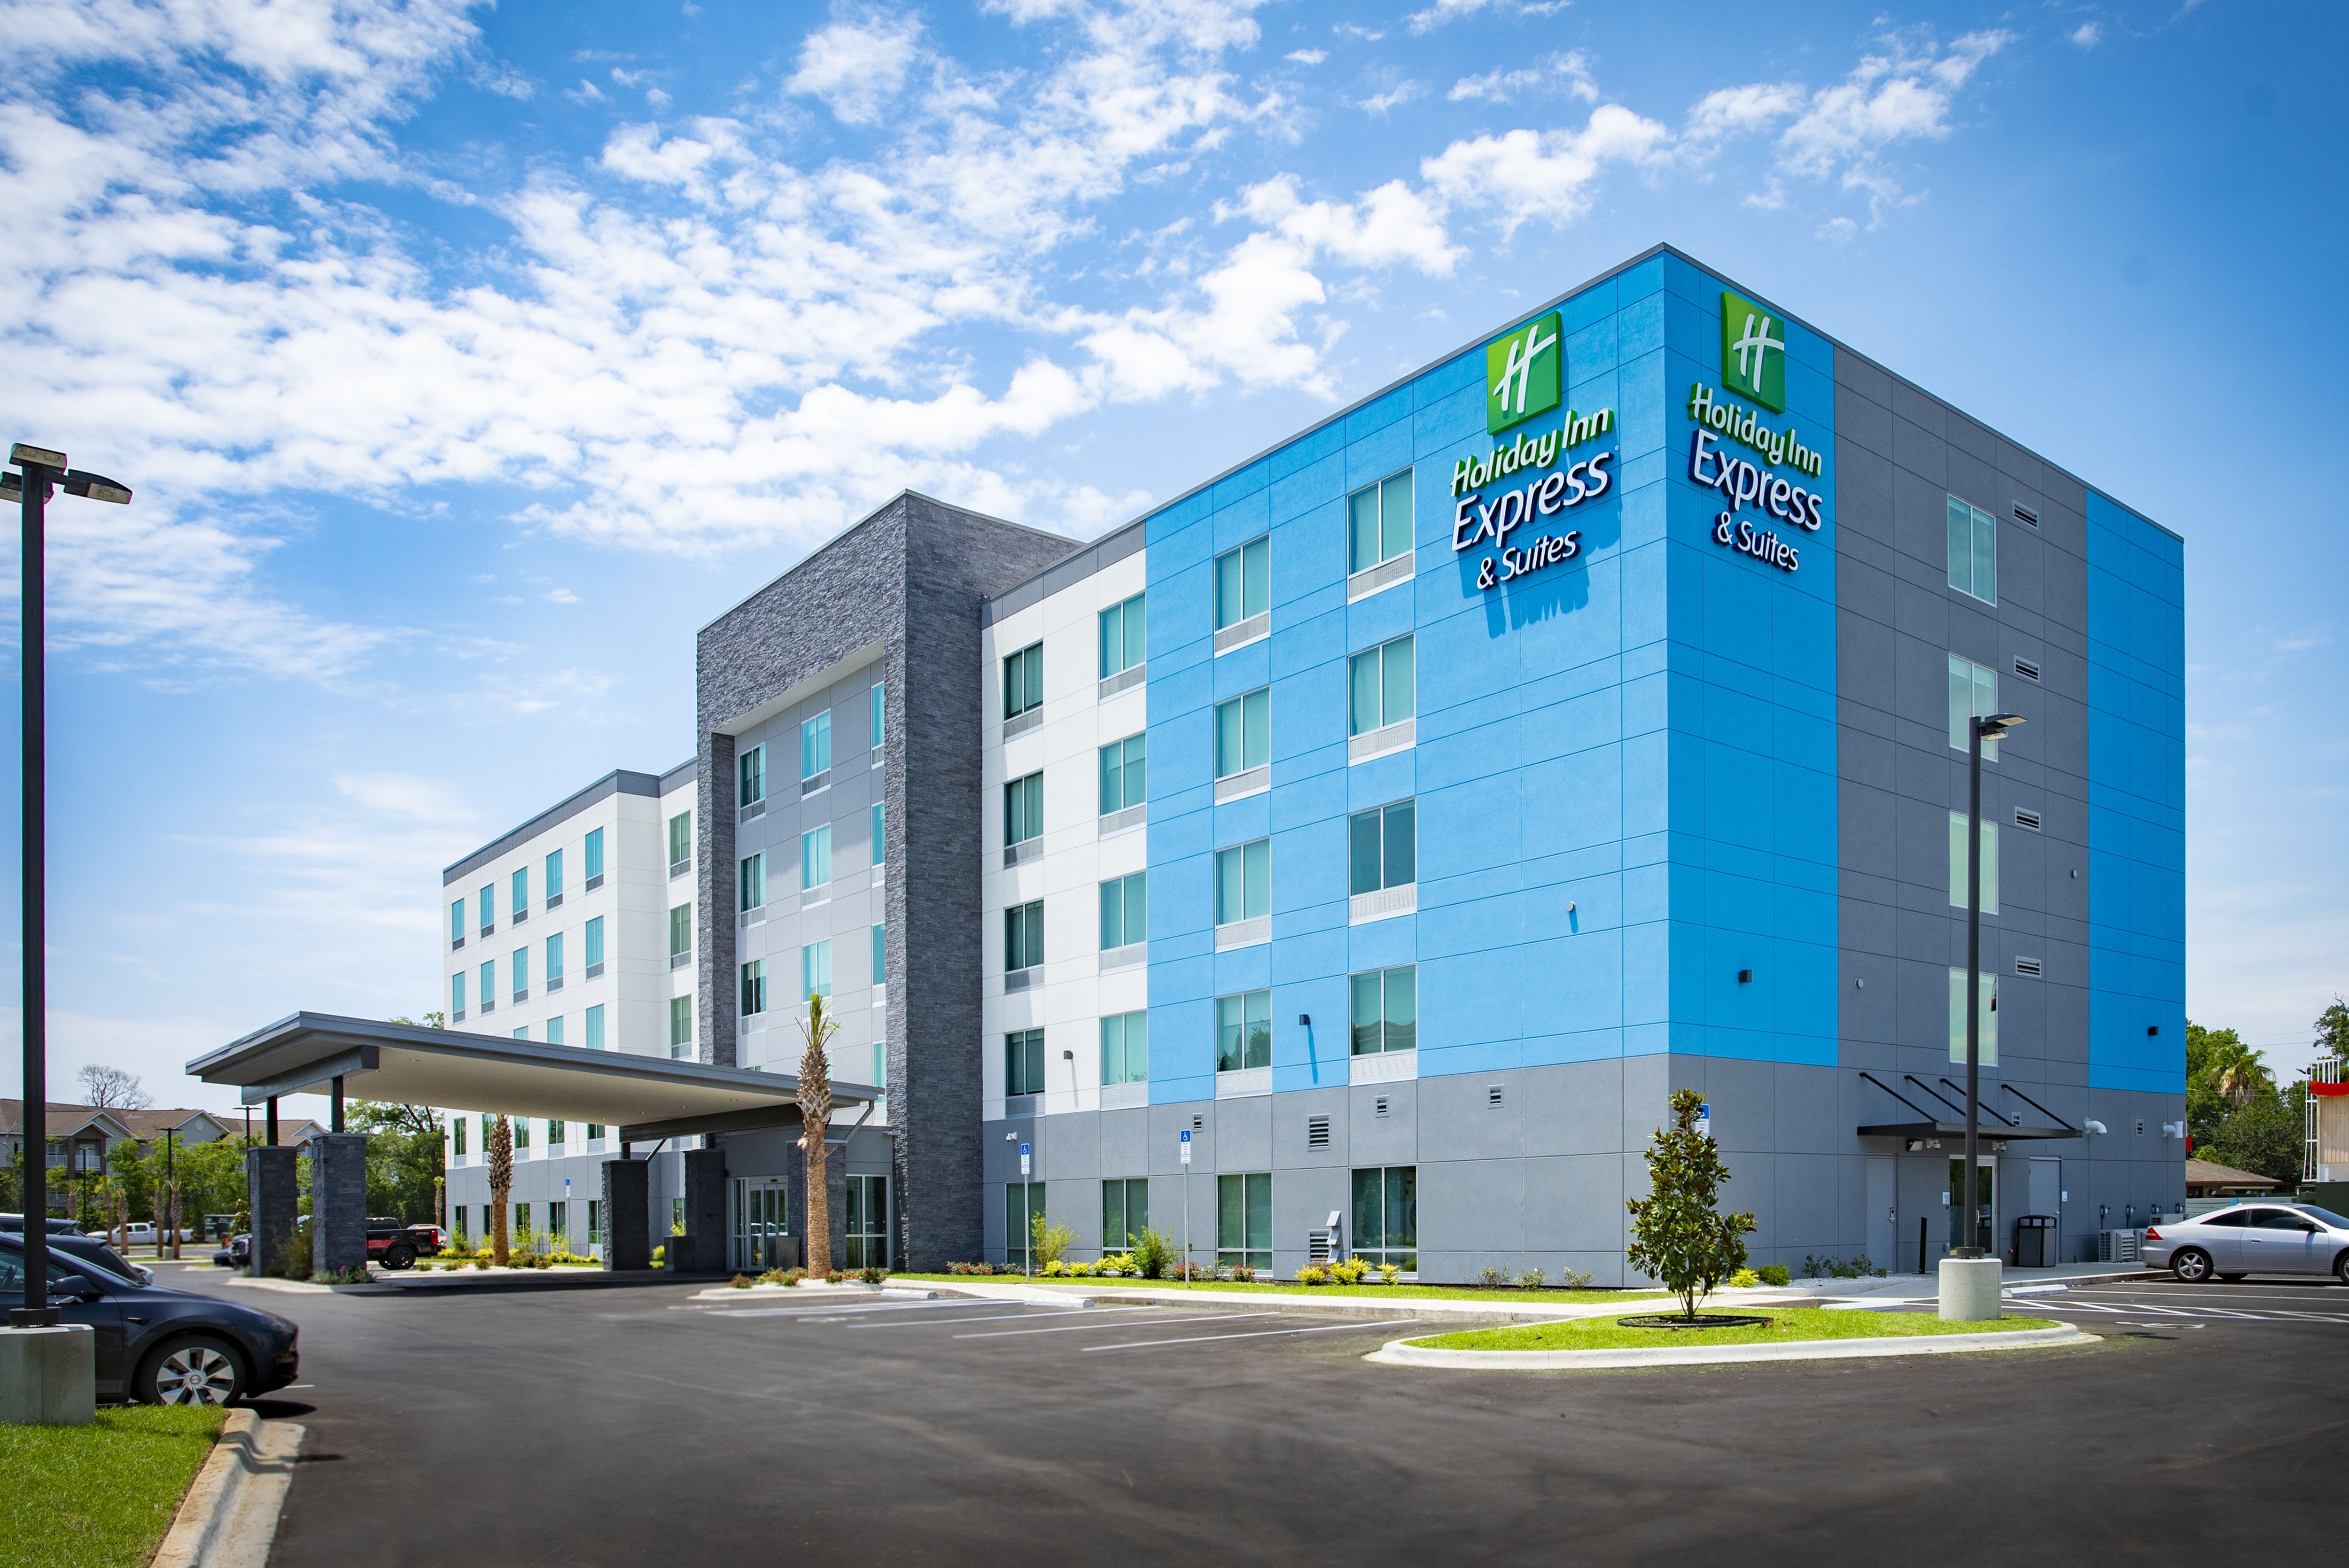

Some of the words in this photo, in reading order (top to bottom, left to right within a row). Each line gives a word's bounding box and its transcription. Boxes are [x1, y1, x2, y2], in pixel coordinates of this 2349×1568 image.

[1450, 428, 1561, 497] Holiday
[1562, 407, 1613, 449] Inn
[1688, 382, 1785, 466] Holiday
[1786, 428, 1822, 477] Inn
[1452, 451, 1614, 551] Express
[1689, 428, 1822, 531] Express
[1477, 557, 1497, 590] &
[1500, 530, 1581, 581] Suites
[1712, 511, 1733, 545] &
[1733, 520, 1799, 572] Suites
